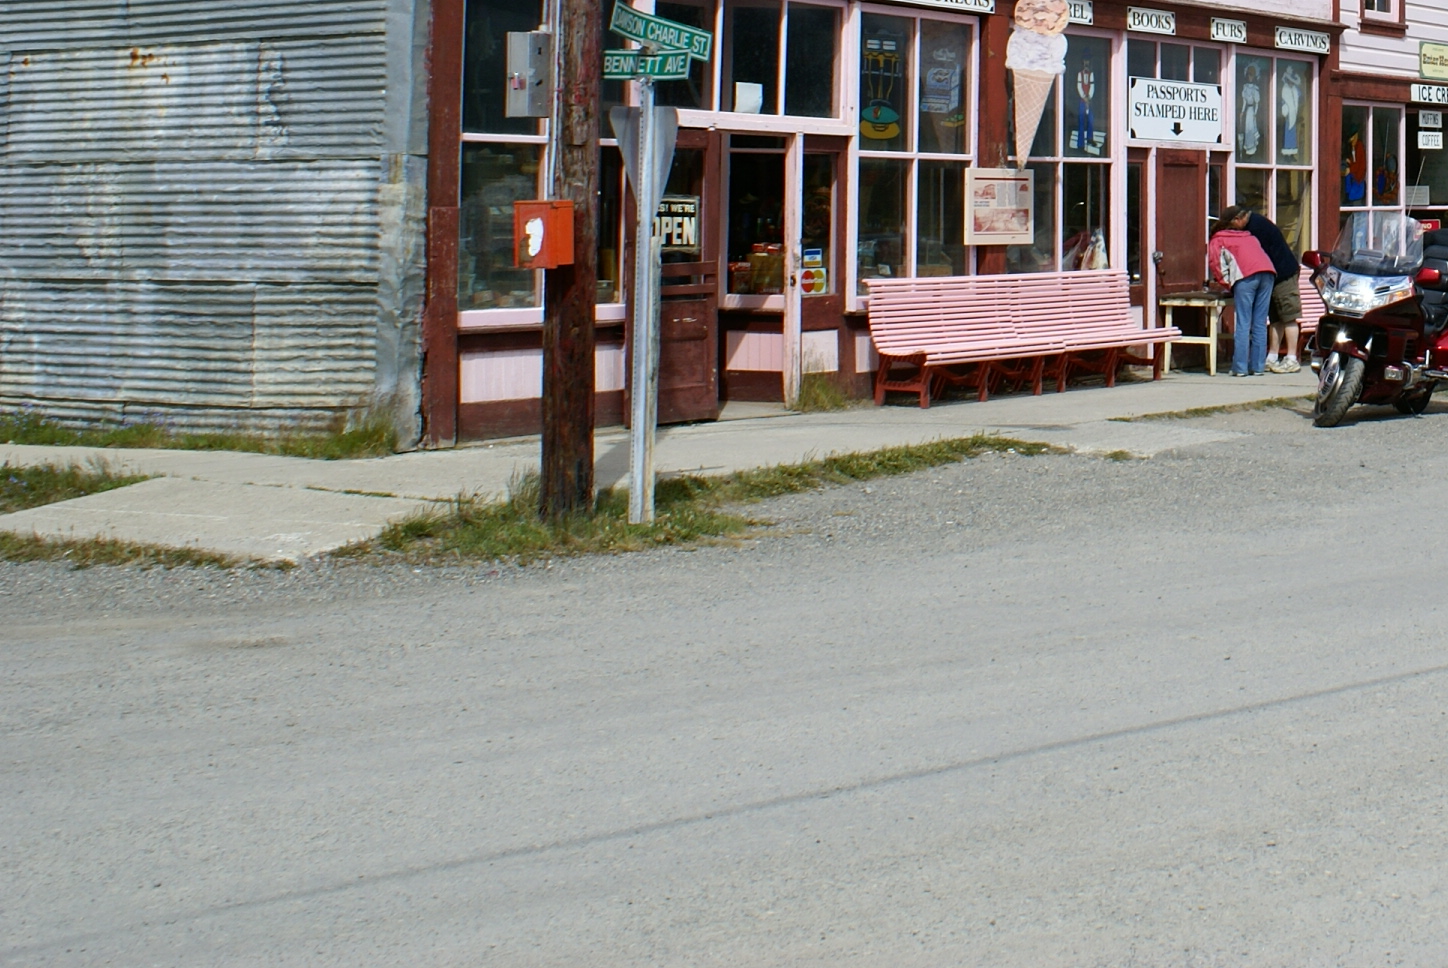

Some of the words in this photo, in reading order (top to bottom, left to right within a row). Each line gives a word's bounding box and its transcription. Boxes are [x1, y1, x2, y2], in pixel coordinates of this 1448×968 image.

[614, 8, 646, 36] DAWSON
[647, 21, 691, 49] CHARLIE
[1132, 11, 1172, 30] BOOKS
[1215, 21, 1243, 39] FURS
[1278, 30, 1327, 50] CARVINGS
[603, 55, 663, 73] BENNETT
[1146, 84, 1207, 104] PASSPORTS
[1418, 85, 1433, 102] ICE
[1134, 101, 1186, 120] STAMPED
[1188, 105, 1219, 122] HERE
